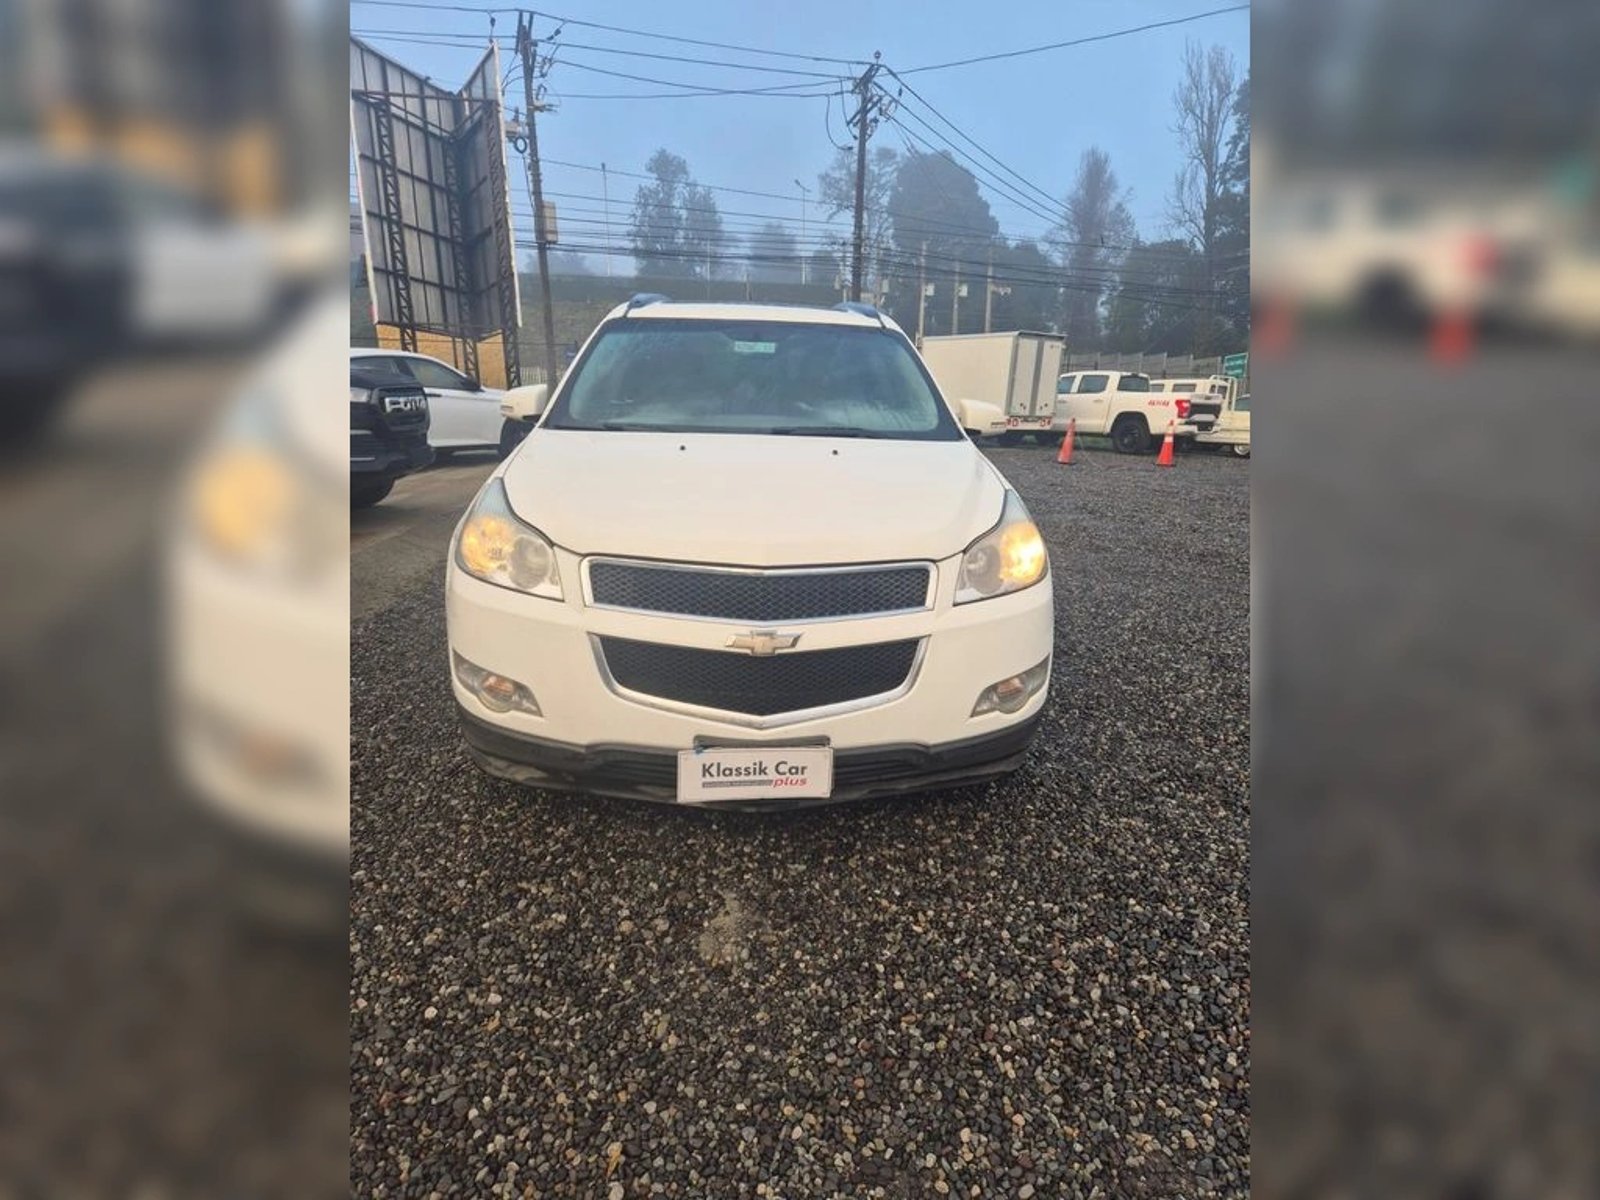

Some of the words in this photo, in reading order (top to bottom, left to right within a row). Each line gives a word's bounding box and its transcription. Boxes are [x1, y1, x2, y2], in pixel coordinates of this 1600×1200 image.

[702, 761, 768, 778] Klassik
[774, 761, 808, 776] Car
[772, 777, 808, 788] plus
